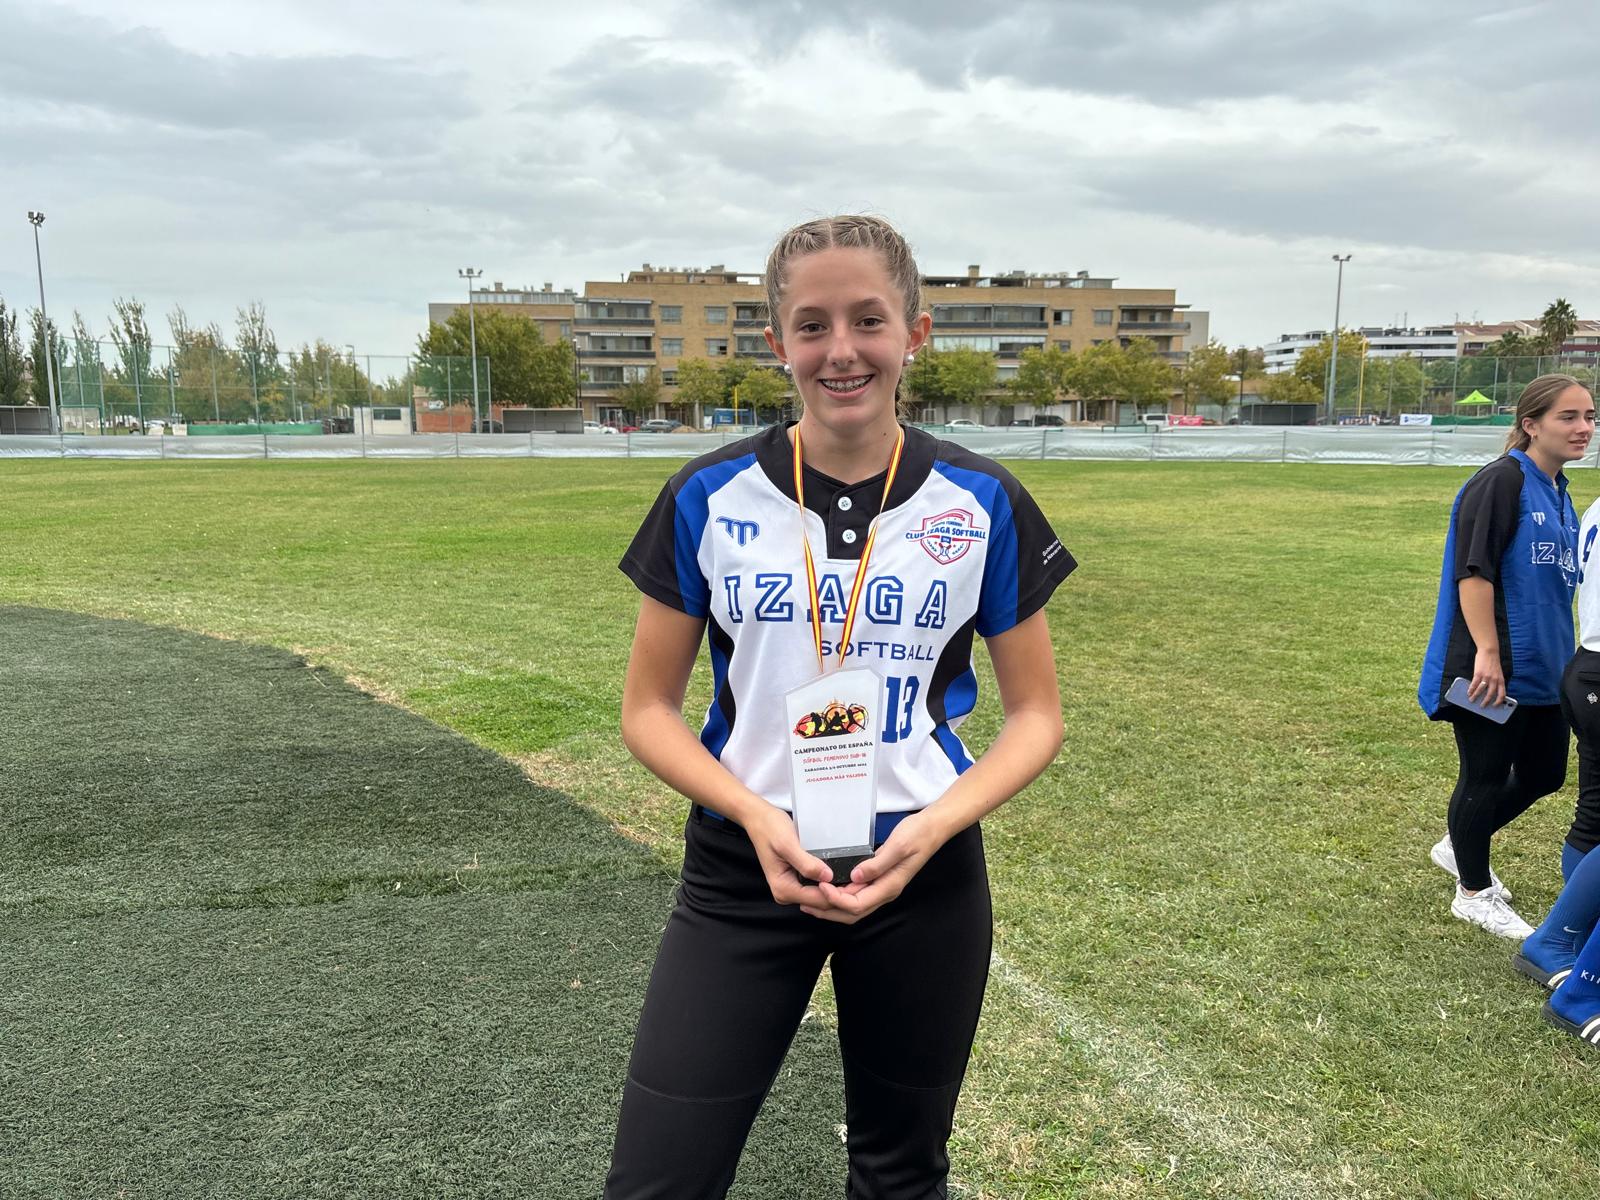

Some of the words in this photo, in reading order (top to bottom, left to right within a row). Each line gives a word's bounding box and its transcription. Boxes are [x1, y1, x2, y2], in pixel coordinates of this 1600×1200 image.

[952, 527, 986, 539] SOFTBALL
[724, 573, 948, 630] IZAGA
[820, 640, 935, 661] SOFTBALL
[882, 675, 920, 743] 13
[794, 745, 838, 754] CAMPEONATO
